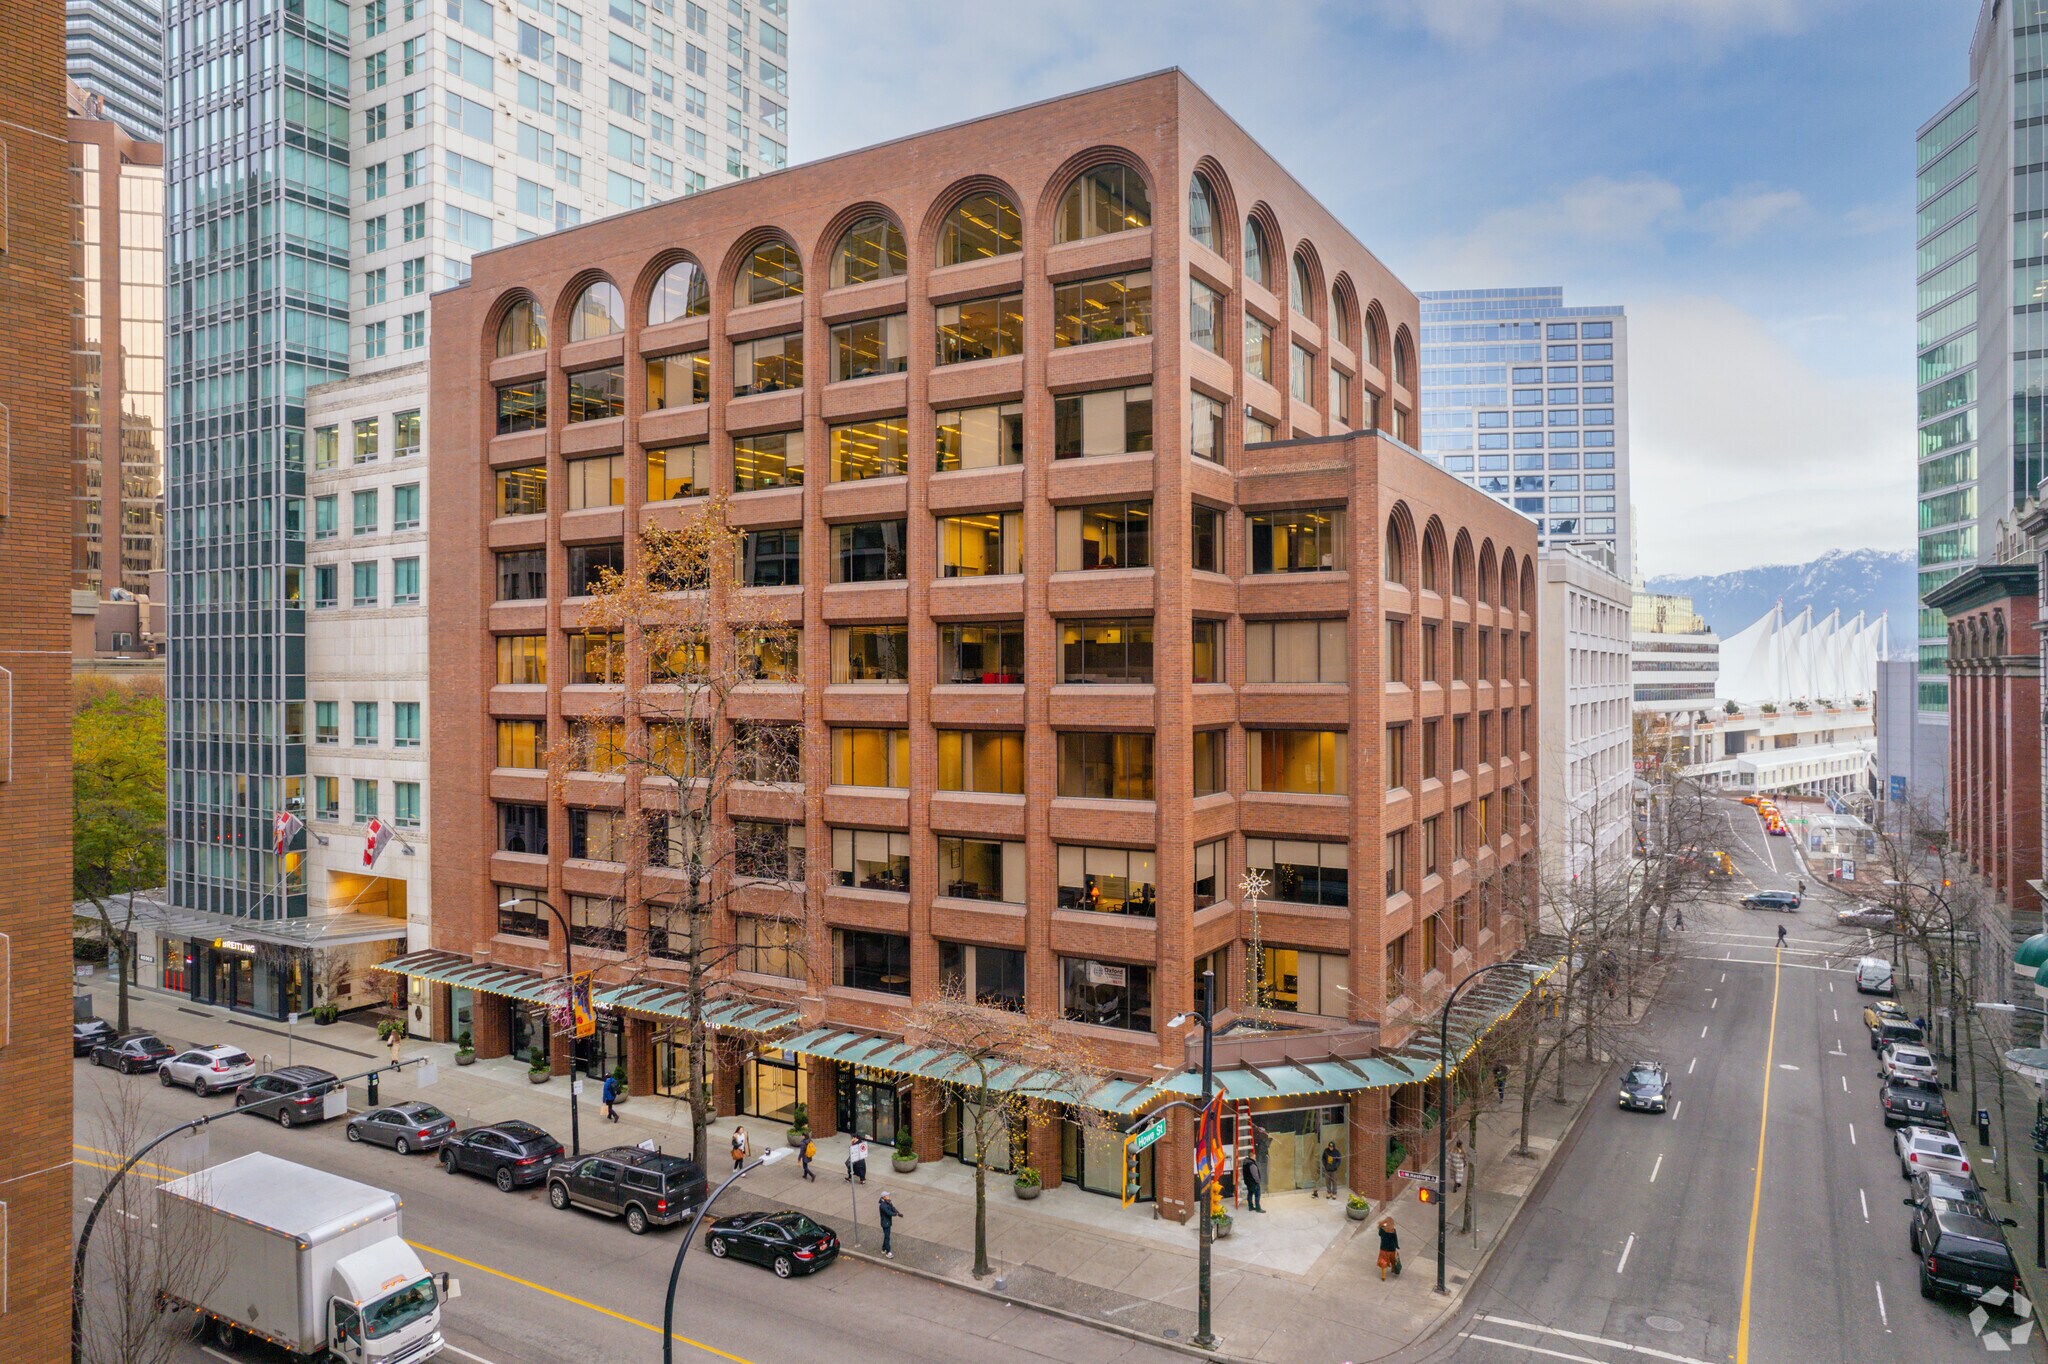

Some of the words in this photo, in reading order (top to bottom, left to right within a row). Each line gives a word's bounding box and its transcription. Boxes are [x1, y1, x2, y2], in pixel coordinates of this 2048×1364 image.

[222, 941, 255, 953] BREITLING
[1104, 967, 1124, 975] Oxford
[1138, 1131, 1155, 1147] Howe
[1156, 1123, 1163, 1136] St
